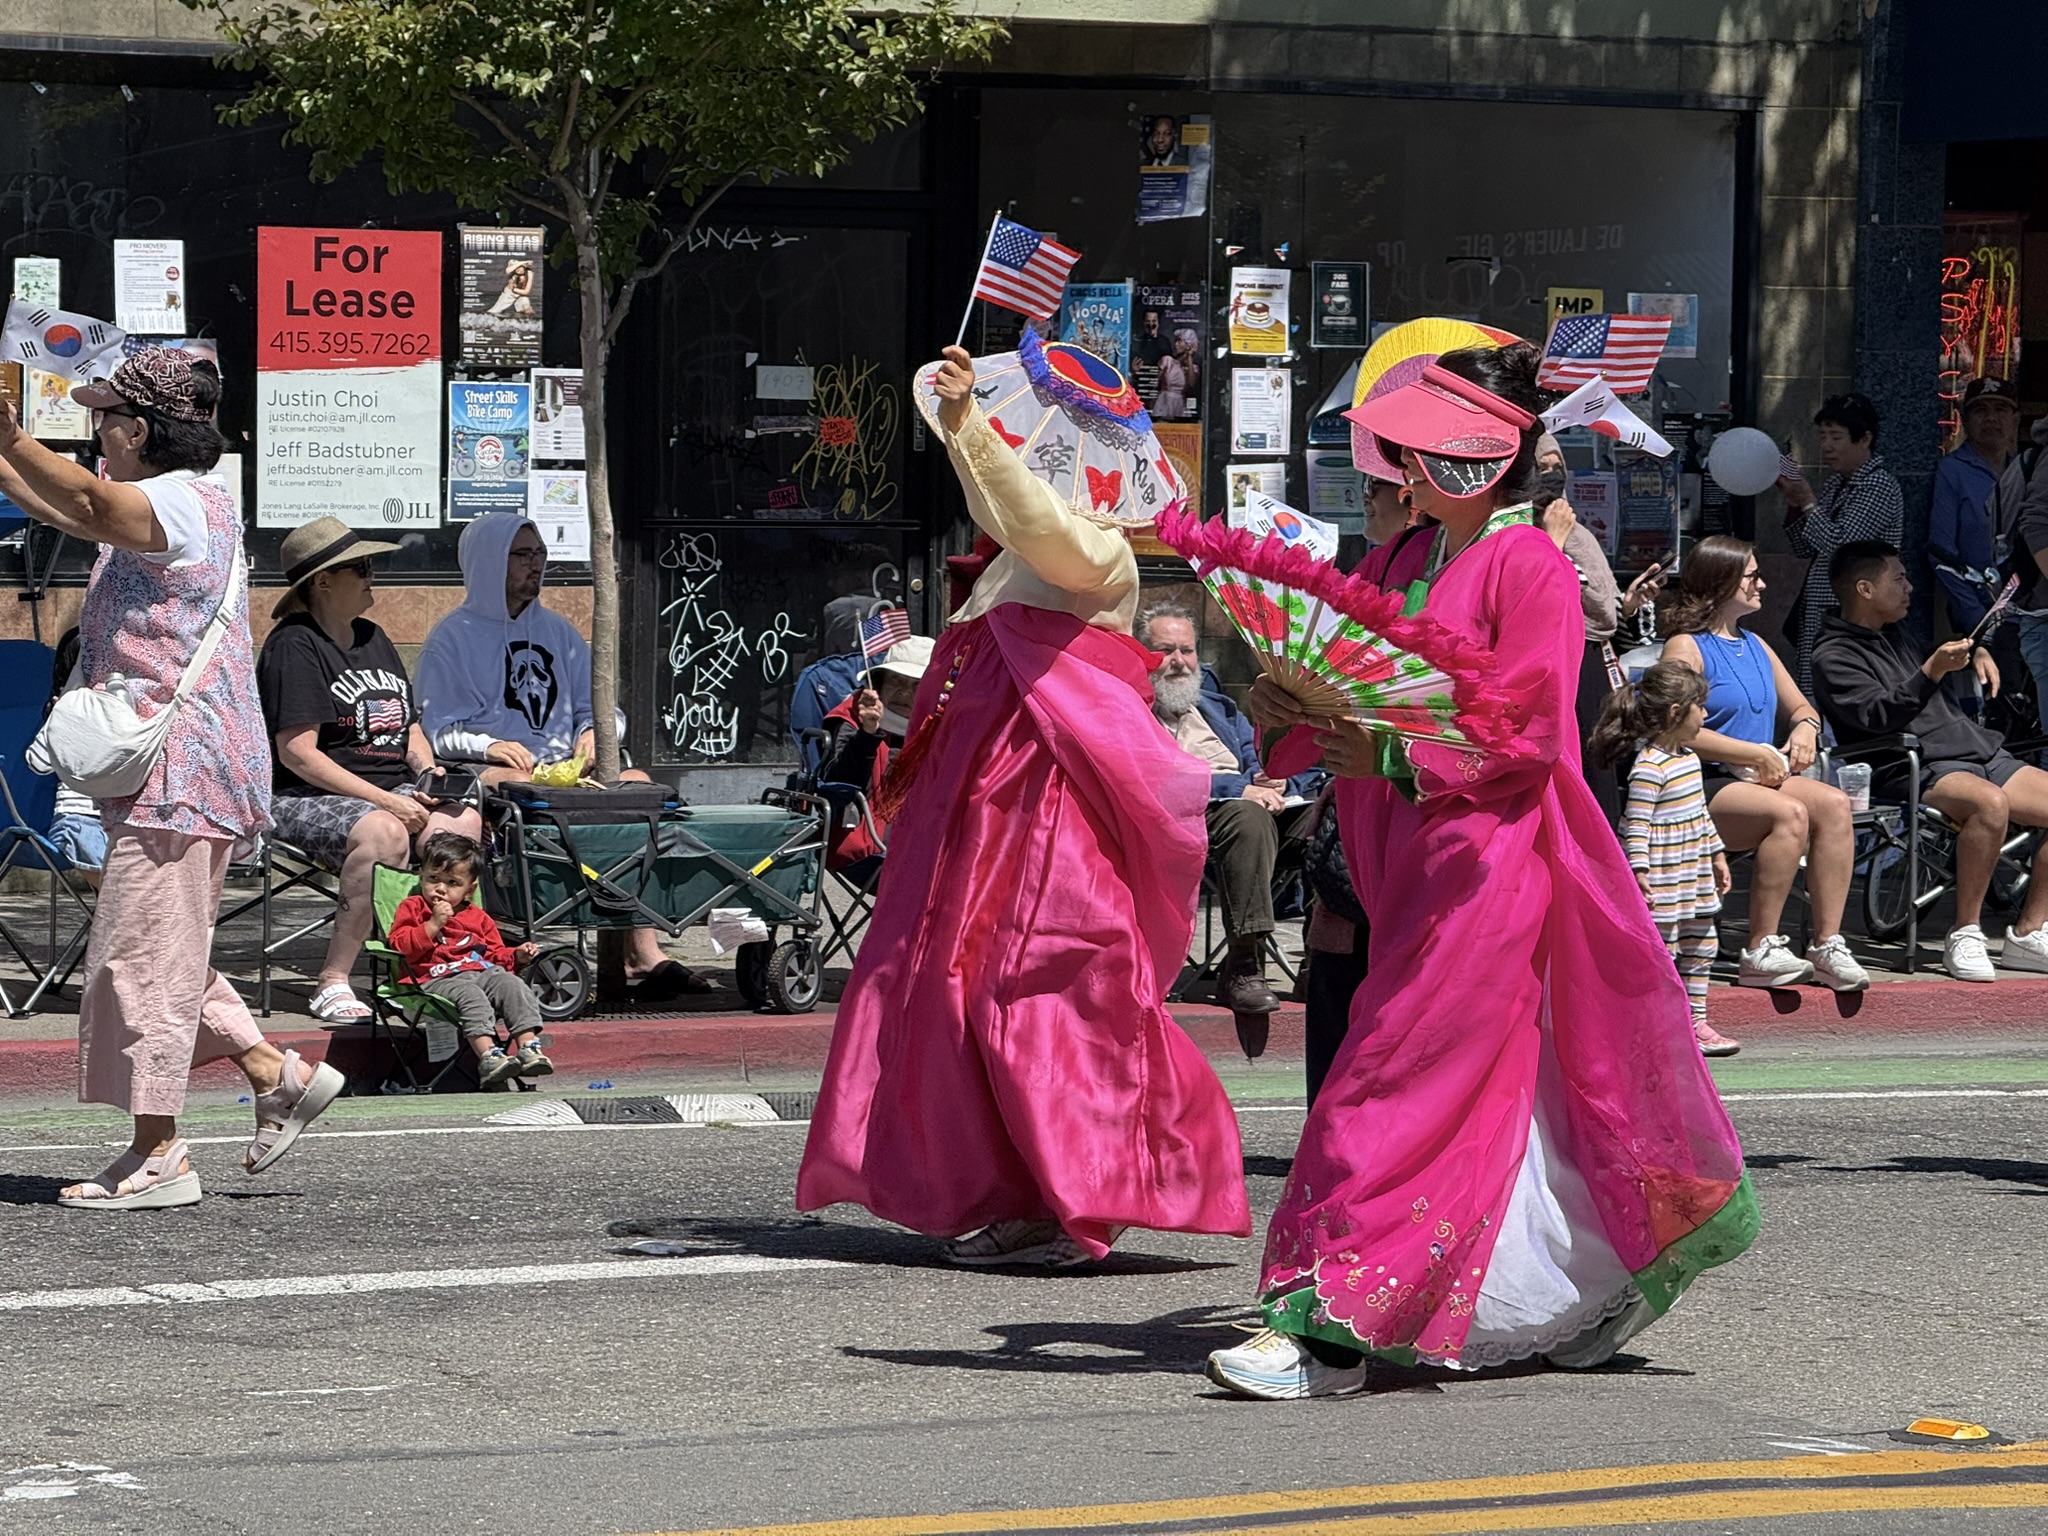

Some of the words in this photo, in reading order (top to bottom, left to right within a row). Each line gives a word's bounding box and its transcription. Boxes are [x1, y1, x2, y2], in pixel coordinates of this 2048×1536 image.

[464, 234, 505, 246] RISING
[507, 235, 540, 247] SEAS
[314, 236, 389, 273] For
[1070, 288, 1097, 297] CIRCUS
[1100, 288, 1122, 297] BELLA
[1136, 286, 1176, 296] POCKET
[1181, 292, 1200, 300] 2025
[286, 280, 415, 319] Lease
[1142, 294, 1175, 306] OPERA
[1068, 301, 1124, 323] HOOPLA!
[270, 331, 430, 355] 415.395.7262
[267, 389, 327, 407] Justin
[334, 390, 379, 407] Choi
[465, 390, 494, 403] Street
[495, 391, 518, 404] Skills
[268, 411, 396, 424] justin.choi@am.jll.com
[467, 404, 486, 418] Bike
[487, 405, 512, 420] Camp
[266, 441, 302, 458] Jeff
[308, 442, 416, 459] Badstubner
[267, 464, 423, 477] jeff.badstubner@am.jll.com
[284, 503, 302, 511] Lang
[330, 503, 367, 511] Brokerage,
[405, 502, 435, 519] JLL
[337, 716, 355, 727] 20
